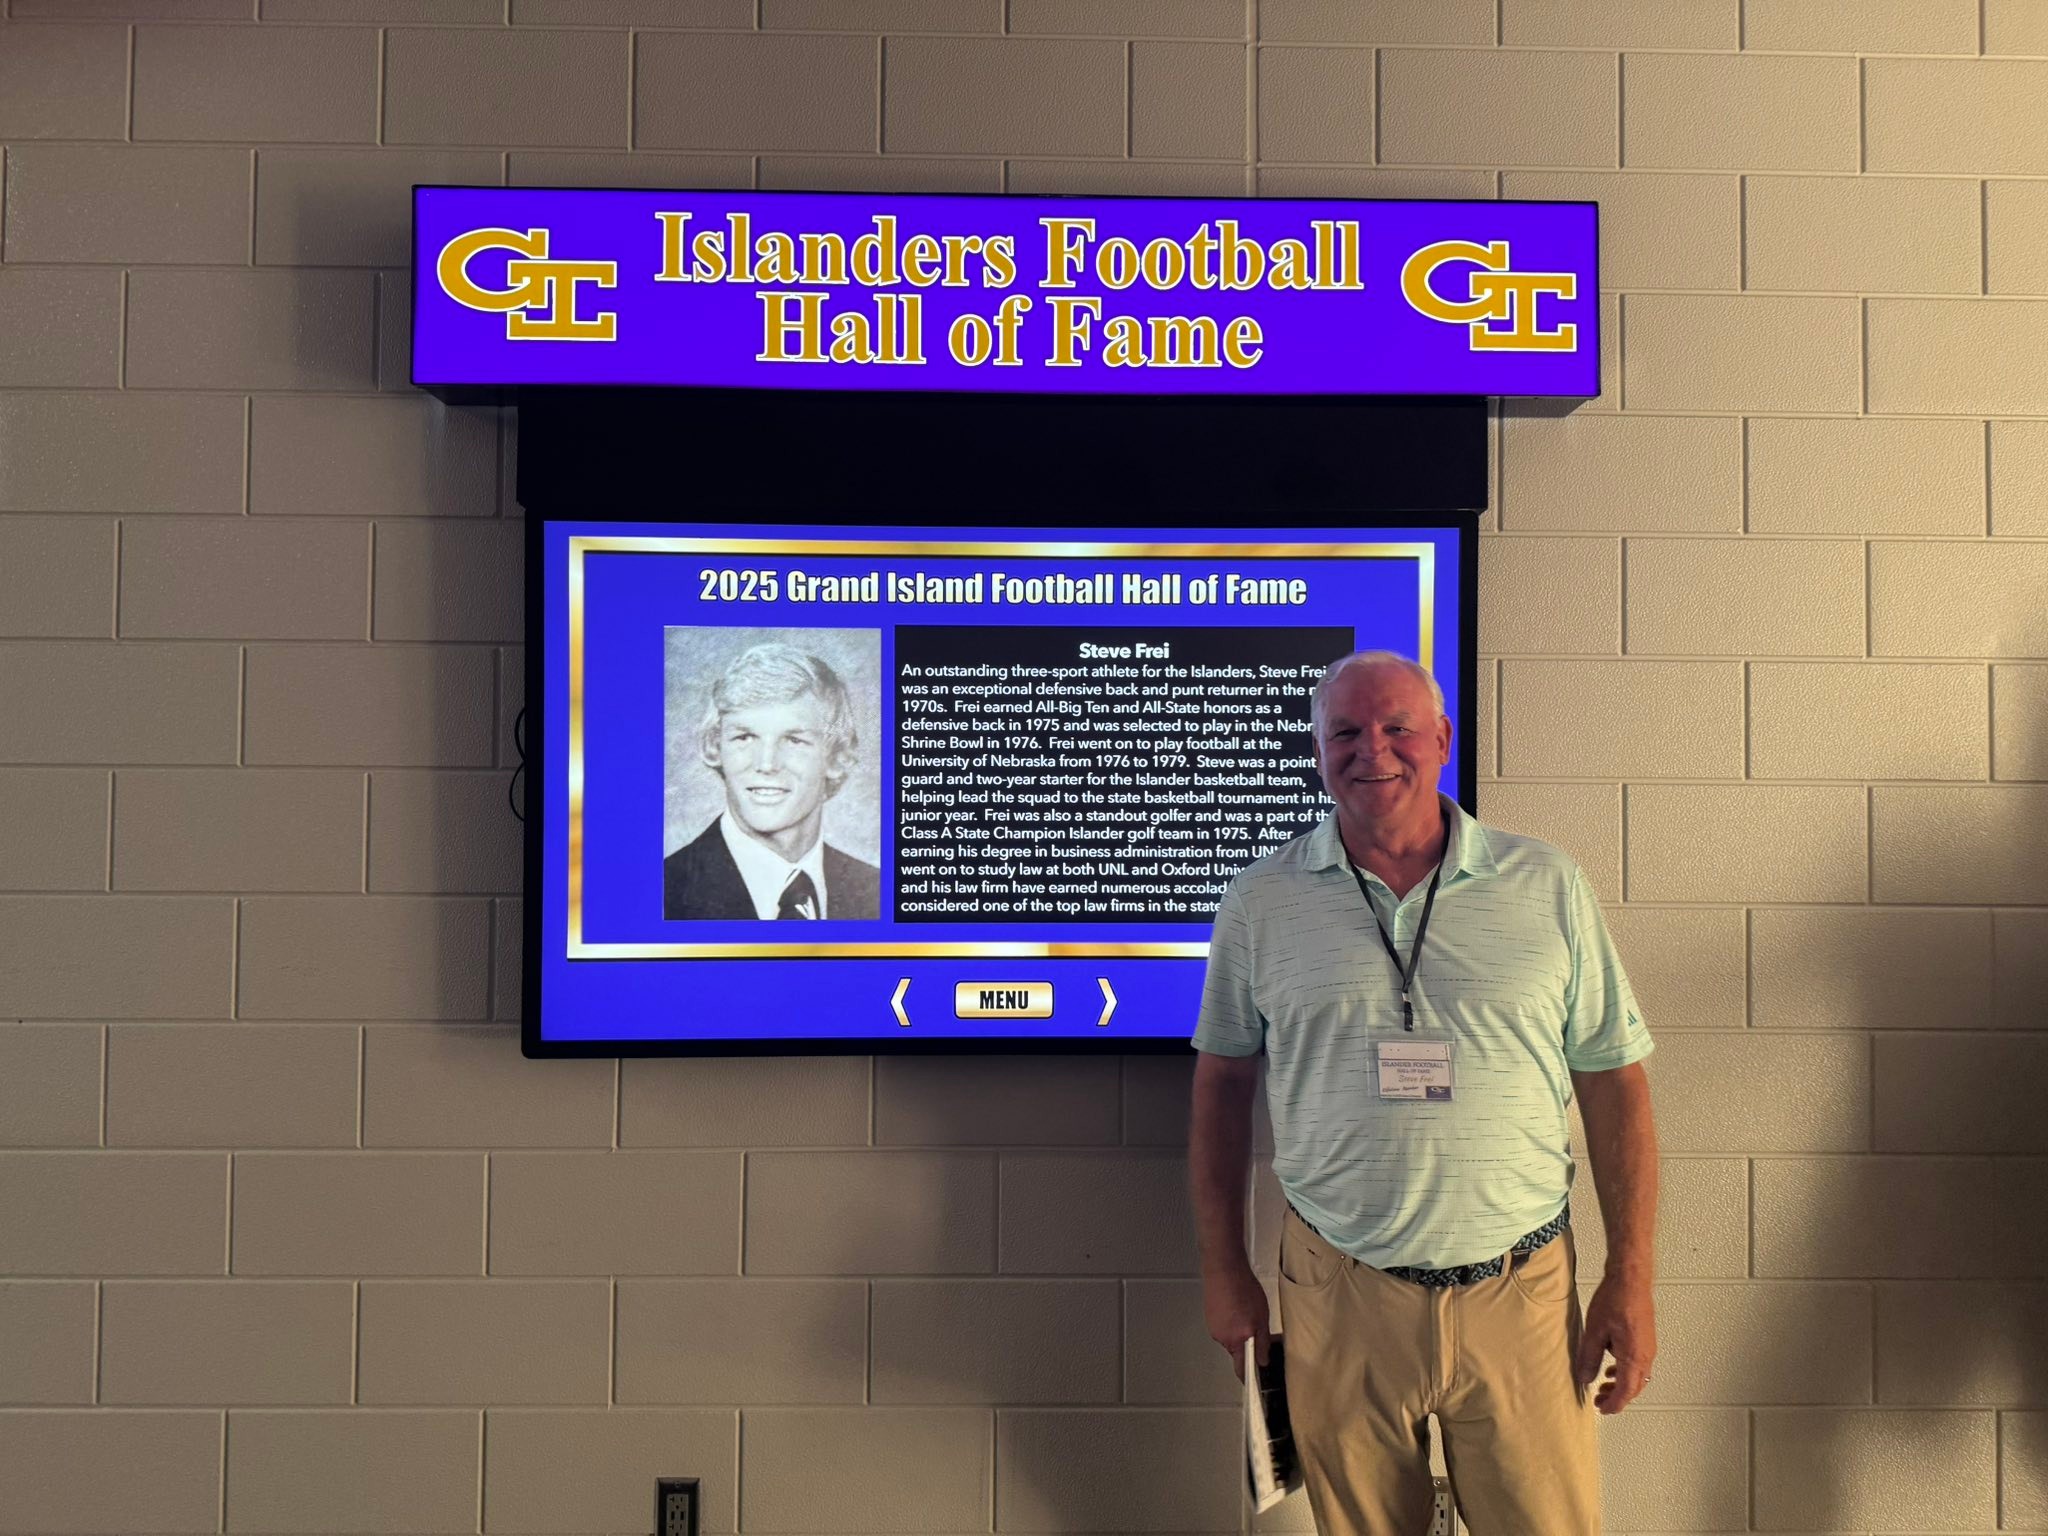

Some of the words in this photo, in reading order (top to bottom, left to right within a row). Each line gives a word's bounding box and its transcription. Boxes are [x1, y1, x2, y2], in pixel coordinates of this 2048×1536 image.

[654, 212, 1017, 288] Islanders
[1039, 217, 1364, 290] Football
[755, 291, 926, 364] Hall
[948, 294, 1033, 366] of
[1045, 296, 1264, 368] Fame
[699, 569, 779, 601] 2025
[787, 570, 880, 602] Grand
[887, 572, 983, 603] Island
[991, 573, 1114, 604] Football
[1122, 573, 1181, 604] Hall
[1188, 574, 1219, 604] of
[1226, 574, 1307, 605] Fame
[1079, 642, 1132, 659] Steve
[1135, 642, 1170, 659] Frei
[901, 663, 922, 676] An
[924, 663, 1008, 681] outstanding
[1010, 663, 1089, 681] three-sport
[1091, 664, 1139, 678] athlete
[1141, 664, 1163, 678] for
[1164, 664, 1188, 678] the
[1191, 664, 1256, 680] Islanders,
[1259, 664, 1298, 678] Steve
[901, 685, 929, 695] was
[931, 685, 949, 695] an
[952, 682, 1032, 698] exceptional
[1035, 681, 1103, 696] defensive
[1105, 682, 1139, 696] back
[1141, 682, 1169, 696] and
[1172, 684, 1205, 699] punt
[1207, 684, 1264, 696] returner
[1266, 683, 1279, 696] in
[1282, 682, 1306, 696] the
[902, 699, 948, 713] 1970s.
[954, 700, 980, 713] Frei
[983, 699, 1033, 713] earned
[1035, 700, 1082, 717] All-Big
[1084, 700, 1110, 714] Ten
[1112, 700, 1140, 714] and
[1142, 700, 1201, 714] All-State
[1203, 700, 1252, 714] honors
[1255, 704, 1271, 714] as
[1273, 704, 1282, 714] a
[901, 717, 969, 731] defensive
[972, 717, 1006, 731] back
[1008, 718, 1022, 731] in
[1025, 718, 1060, 732] 1975
[1063, 718, 1090, 732] and
[1093, 722, 1120, 732] was
[1122, 718, 1181, 732] selected
[1184, 720, 1200, 732] to
[1202, 718, 1232, 736] play
[1234, 719, 1248, 732] in
[1250, 718, 1274, 732] the
[1277, 718, 1313, 732] Nebr
[901, 735, 947, 749] Shrine
[949, 735, 984, 749] Bowl
[987, 736, 1000, 749] in
[1004, 736, 1042, 749] 1976.
[1049, 736, 1075, 750] Frei
[1077, 738, 1112, 750] went
[1114, 740, 1133, 750] on
[1135, 738, 1152, 750] to
[1154, 736, 1184, 753] play
[1185, 736, 1240, 750] football
[1242, 738, 1257, 750] at
[1258, 736, 1282, 750] the
[901, 754, 970, 771] University
[972, 753, 988, 767] of
[990, 753, 1056, 768] Nebraska
[1058, 753, 1092, 768] from
[1096, 754, 1131, 768] 1976
[1132, 756, 1149, 768] to
[1152, 754, 1190, 768] 1979.
[1196, 754, 1236, 768] Steve
[1237, 758, 1265, 768] was
[1267, 758, 1277, 768] a
[1279, 755, 1317, 772] point
[901, 771, 943, 789] guard
[946, 772, 973, 785] and
[976, 774, 1037, 789] two-year
[1039, 774, 1085, 786] starter
[1086, 772, 1107, 786] for
[1108, 772, 1133, 786] the
[1136, 772, 1191, 786] Islander
[1194, 772, 1265, 786] basketball
[1266, 775, 1307, 788] team,
[901, 789, 955, 807] helping
[958, 789, 988, 803] lead
[991, 790, 1015, 803] the
[1017, 790, 1061, 807] squad
[1063, 792, 1079, 804] to
[1081, 790, 1105, 804] the
[1107, 792, 1141, 804] state
[1144, 790, 1215, 804] basketball
[1217, 792, 1300, 804] tournament
[1302, 791, 1315, 804] in
[900, 808, 942, 825] junior
[944, 811, 978, 825] year.
[984, 808, 1010, 822] Frei
[1013, 812, 1040, 822] was
[1043, 808, 1072, 822] also
[1074, 812, 1083, 822] a
[1086, 808, 1148, 822] standout
[1150, 808, 1193, 826] golfer
[1194, 808, 1222, 822] and
[1224, 812, 1252, 822] was
[1254, 812, 1263, 822] a
[1266, 811, 1296, 826] part
[1297, 808, 1313, 823] of
[1314, 809, 1329, 823] th
[901, 825, 939, 839] Class
[940, 826, 953, 839] A
[955, 826, 991, 840] State
[993, 826, 1066, 843] Champion
[1069, 826, 1125, 840] Islander
[1127, 826, 1156, 843] golf
[1157, 828, 1194, 840] team
[1197, 827, 1210, 840] in
[1213, 826, 1252, 840] 1975.
[1257, 826, 1294, 840] After
[901, 844, 955, 861] earning
[958, 844, 978, 858] his
[981, 844, 1032, 861] degree
[1035, 845, 1048, 857] in
[1051, 844, 1111, 858] business
[1114, 844, 1213, 858] administration
[1215, 844, 1249, 858] from
[900, 898, 979, 912] considered
[982, 902, 1010, 912] one
[1012, 898, 1028, 912] of
[1030, 898, 1054, 912] the
[1056, 900, 1081, 915] top
[1084, 898, 1108, 912] law
[1110, 898, 1145, 912] firms
[1148, 899, 1161, 912] in
[1163, 898, 1188, 912] the
[979, 990, 1029, 1009] MENU
